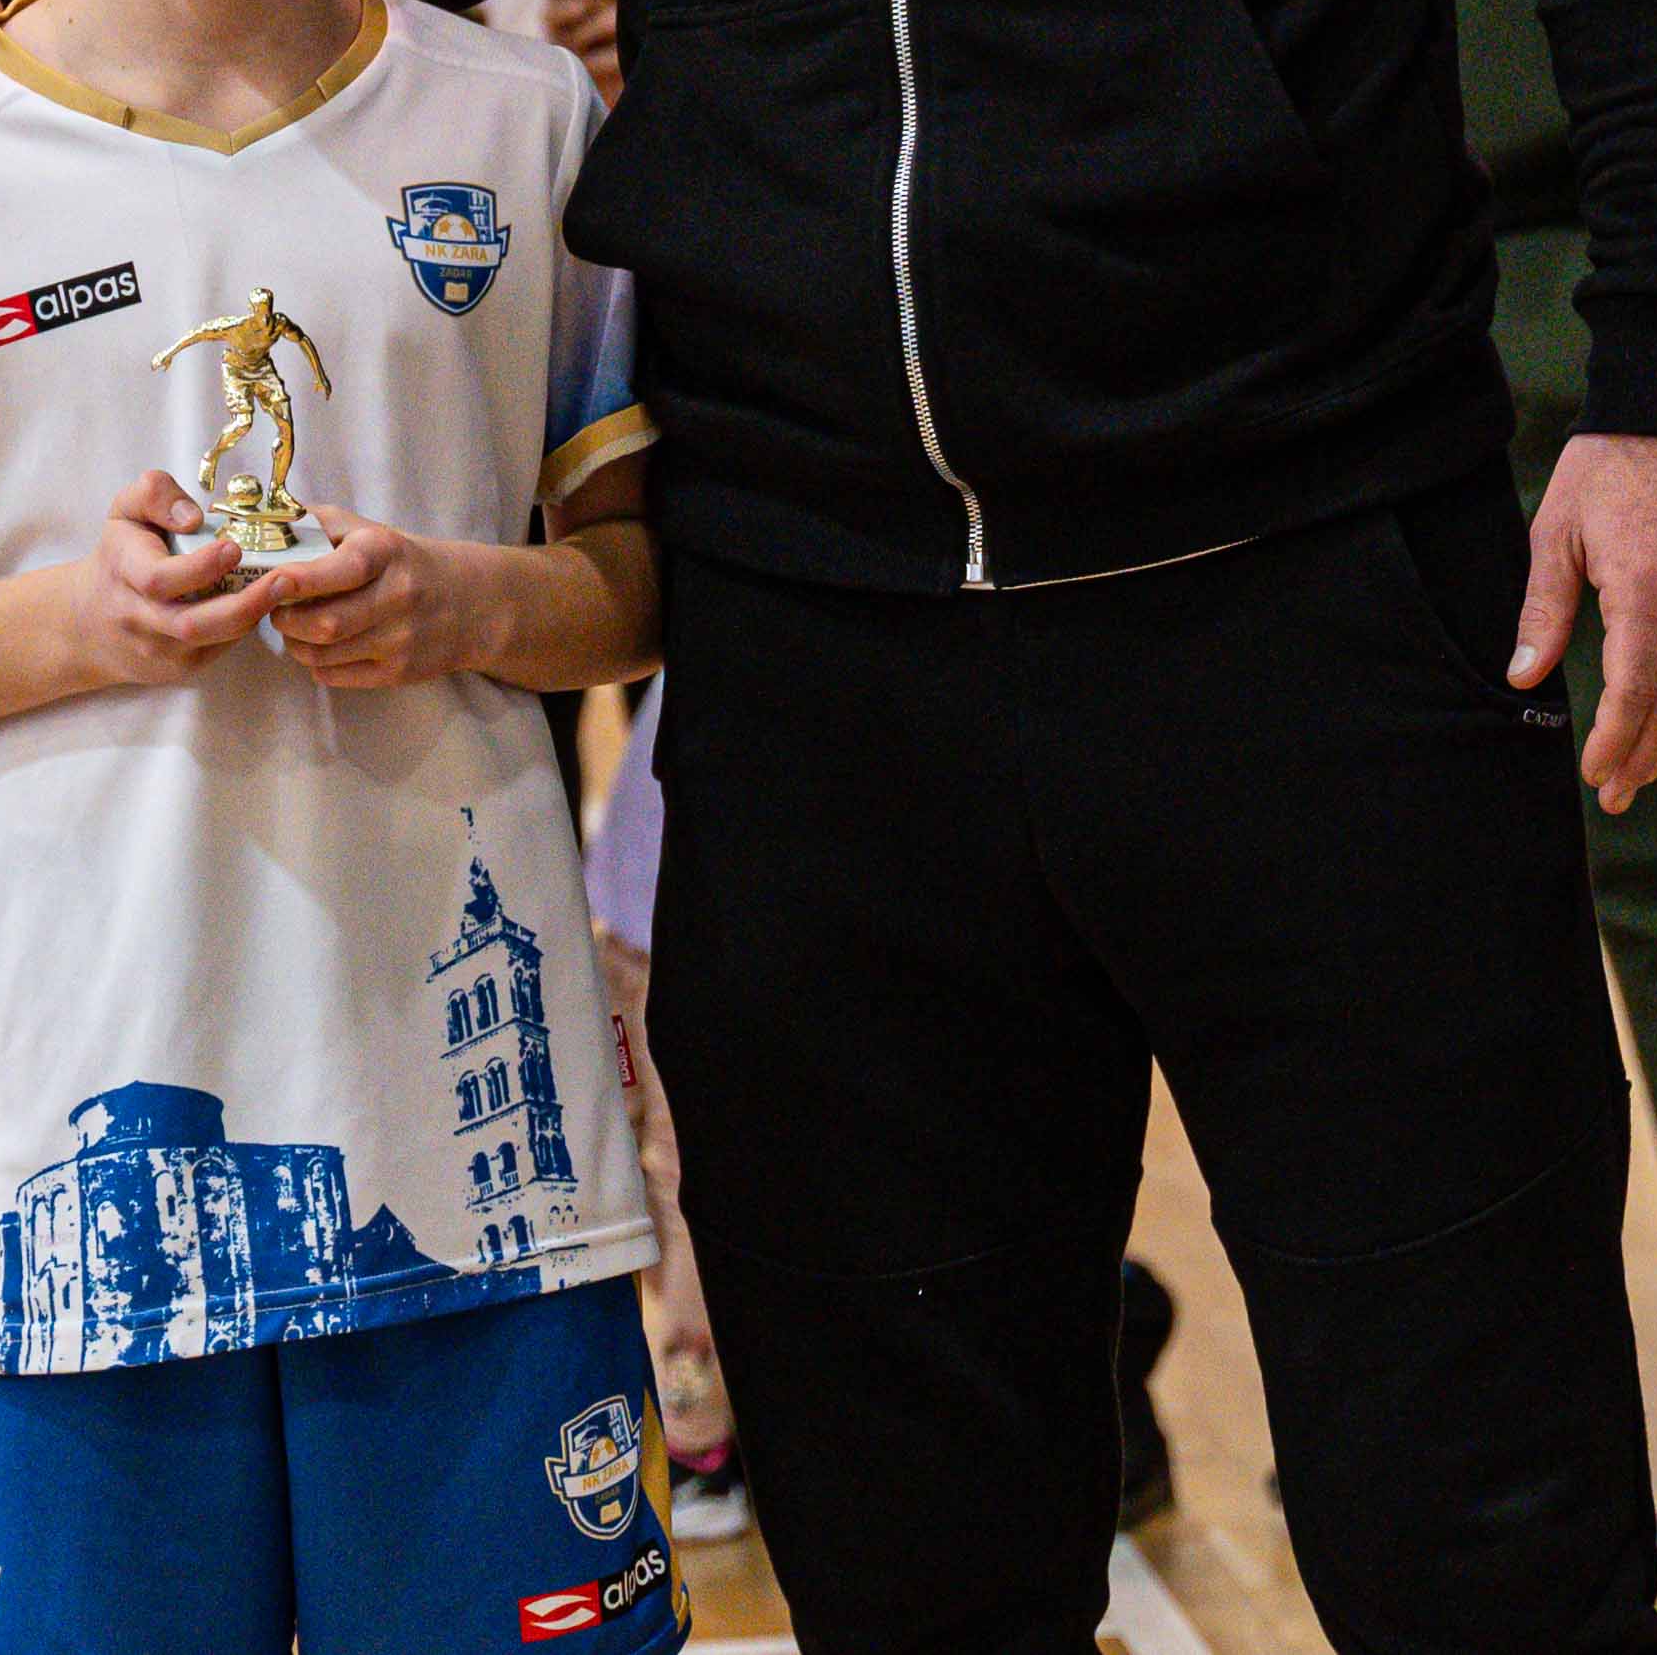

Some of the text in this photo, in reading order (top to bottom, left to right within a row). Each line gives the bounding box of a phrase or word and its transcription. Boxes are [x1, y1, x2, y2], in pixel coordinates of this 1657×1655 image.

[424, 243, 488, 262] NK ZARA
[34, 271, 136, 320] alpas
[603, 1549, 666, 1610] alpas
